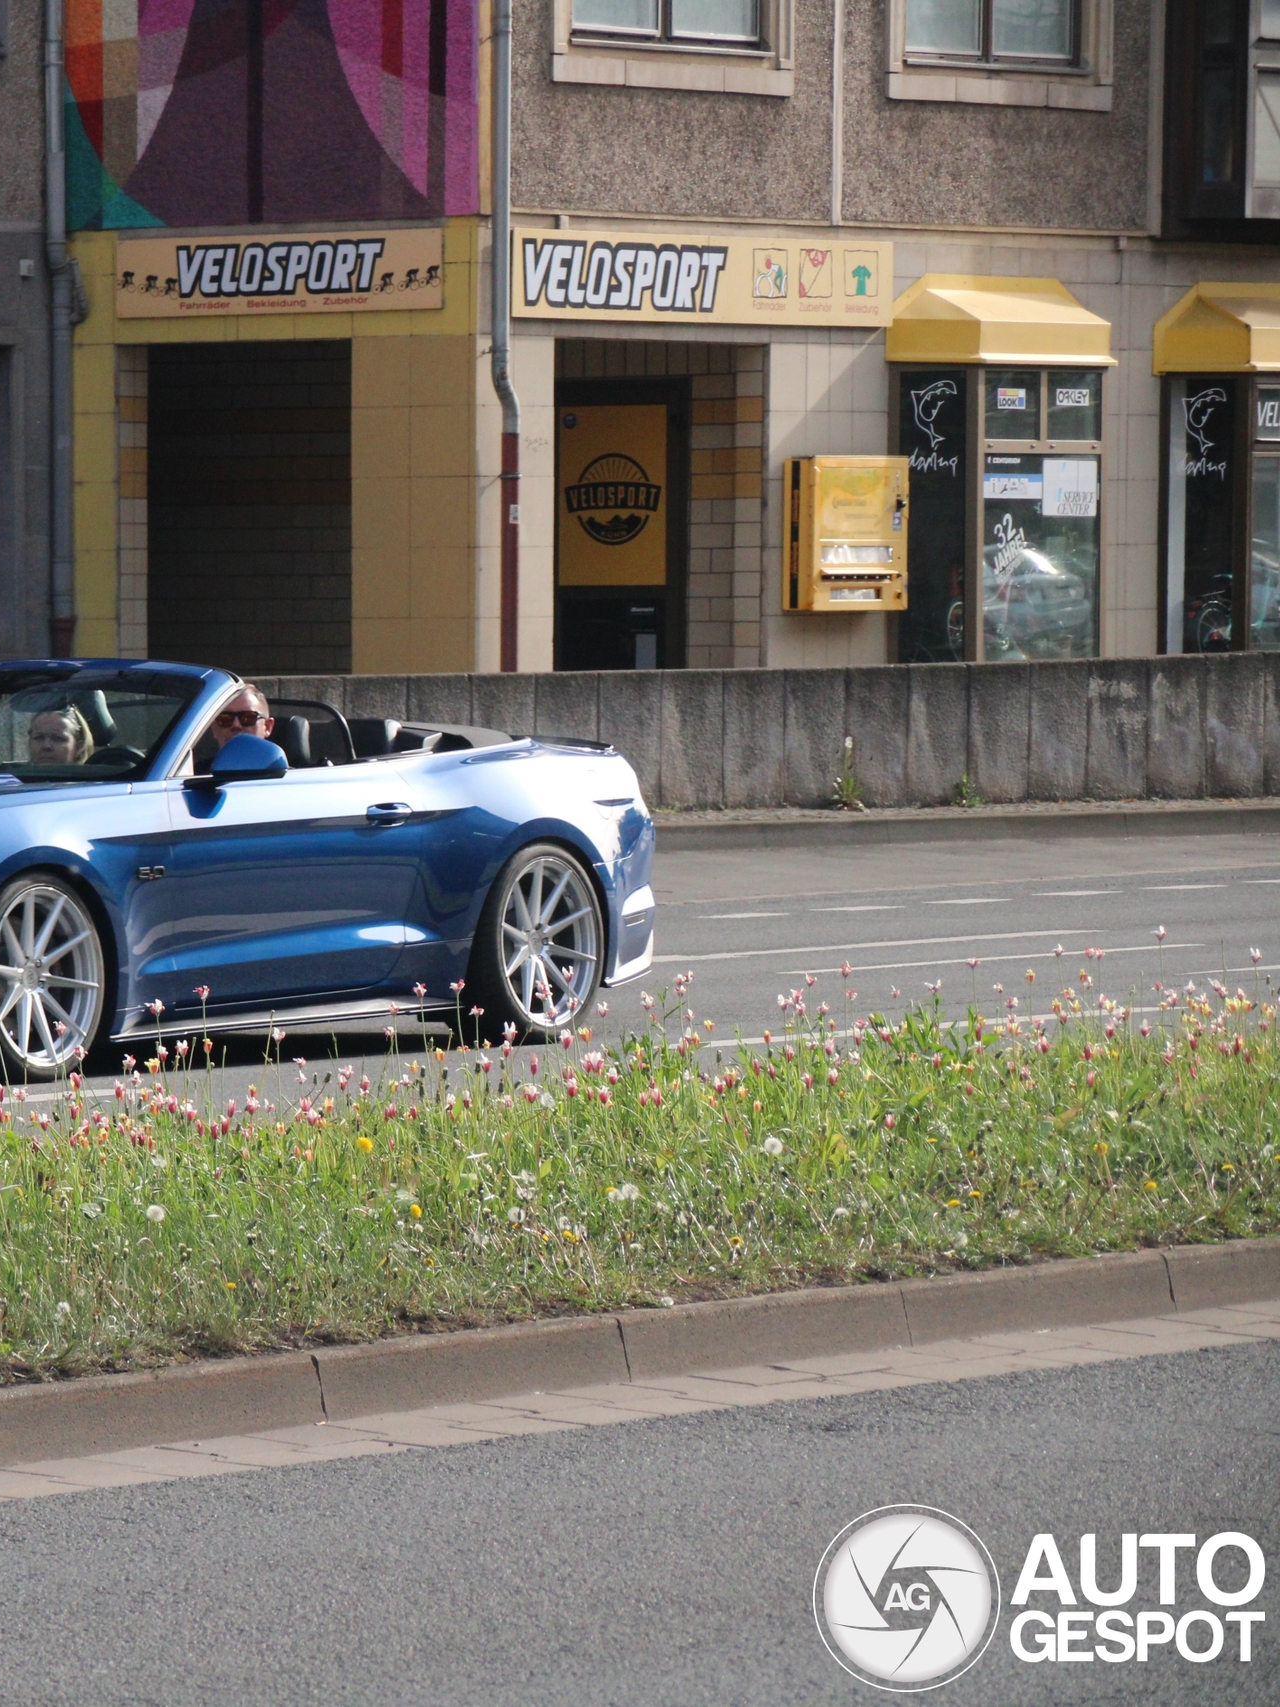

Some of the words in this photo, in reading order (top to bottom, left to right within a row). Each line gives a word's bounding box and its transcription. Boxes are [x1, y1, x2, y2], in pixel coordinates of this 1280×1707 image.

[177, 238, 384, 298] VELOSPORT
[522, 238, 727, 312] VELOSPORT
[179, 300, 231, 310] Fahrräder
[247, 299, 307, 310] Bekleidung
[323, 296, 369, 306] Zubehör
[999, 398, 1018, 407] LOOK
[1058, 390, 1088, 404] OAKLEY
[569, 486, 658, 509] VELOSPORT
[1064, 491, 1096, 504] SERVICE
[1057, 503, 1090, 515] CENTER
[994, 513, 1017, 549] 32
[139, 866, 165, 879] 5.0
